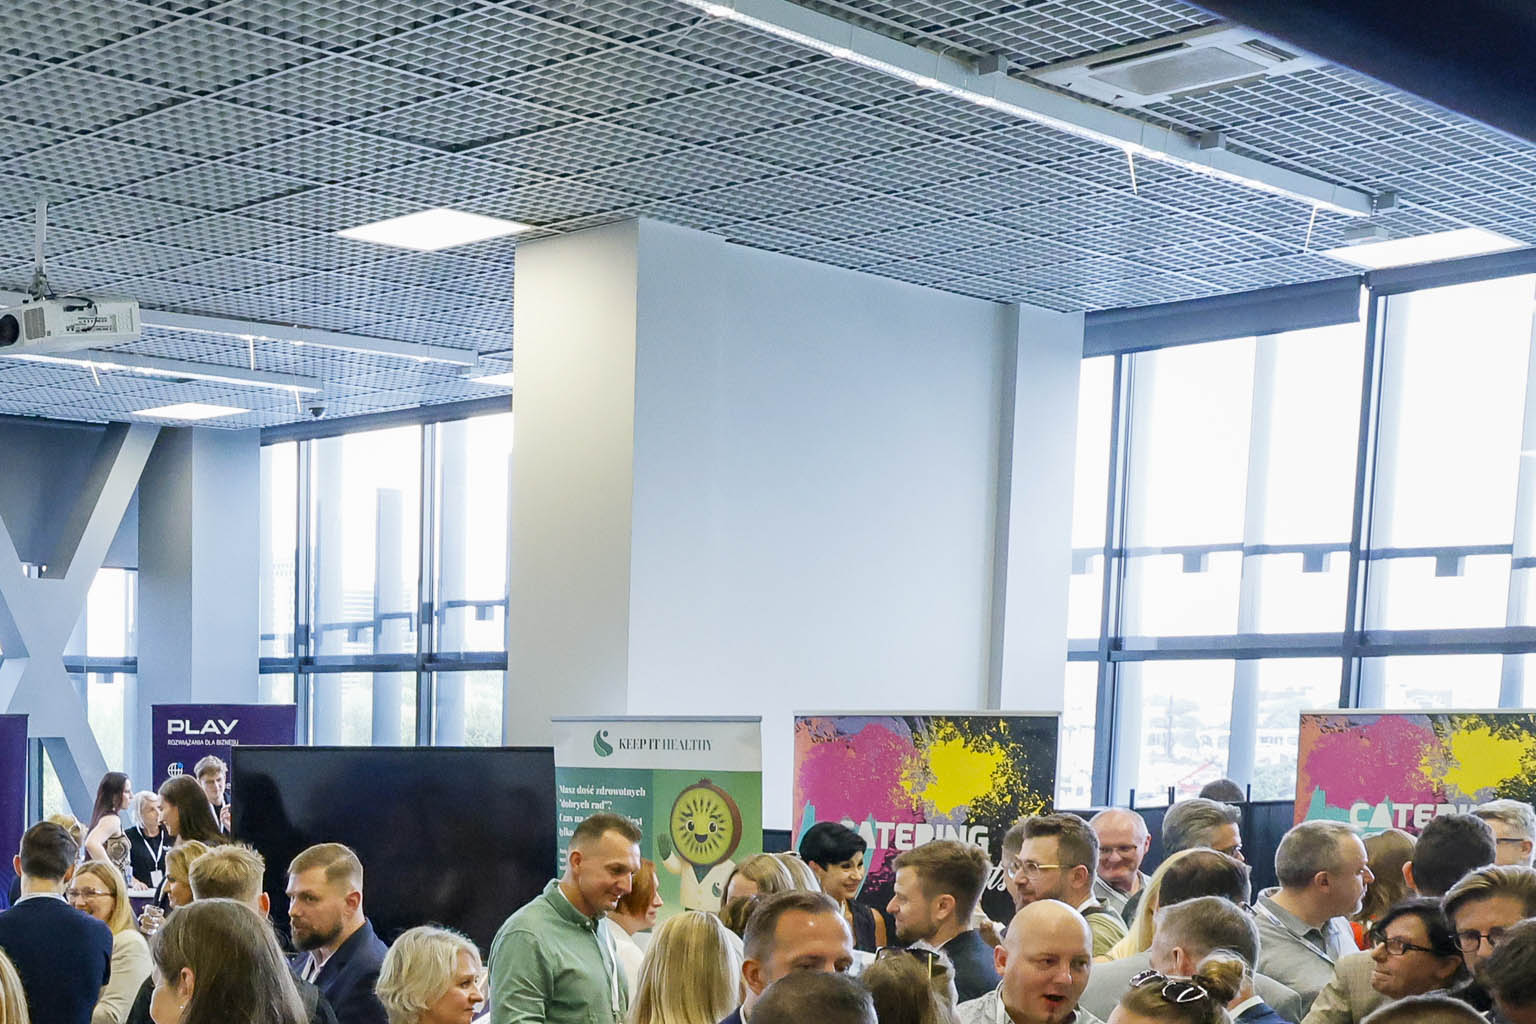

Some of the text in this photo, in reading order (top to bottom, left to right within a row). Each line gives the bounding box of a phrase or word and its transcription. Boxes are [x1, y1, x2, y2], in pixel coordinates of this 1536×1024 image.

[167, 719, 239, 735] PLAY
[619, 738, 712, 751] KEEP IT HEALTHY
